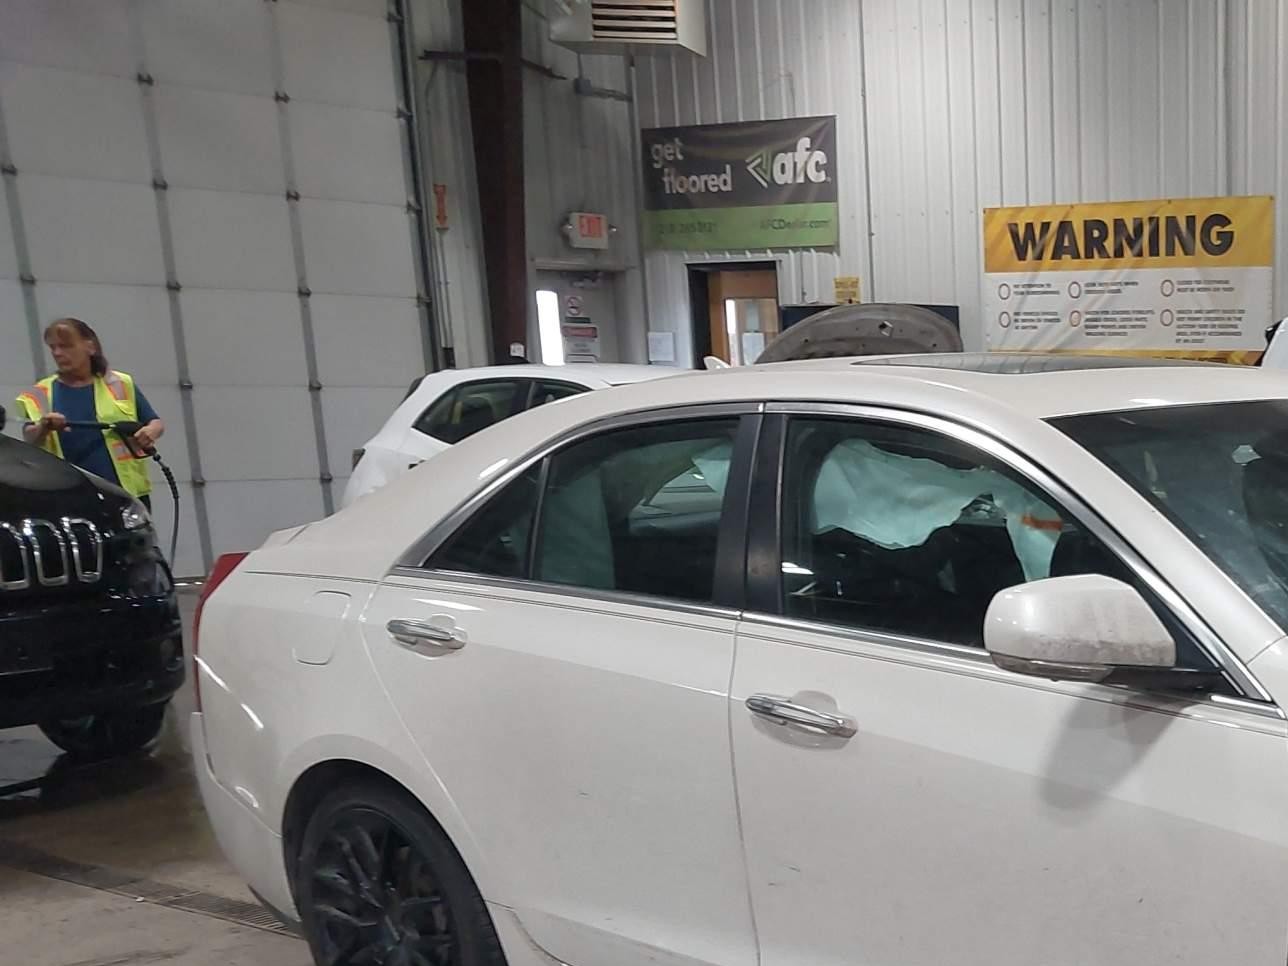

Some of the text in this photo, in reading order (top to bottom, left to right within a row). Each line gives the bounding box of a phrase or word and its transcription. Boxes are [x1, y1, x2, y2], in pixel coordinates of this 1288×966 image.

[651, 137, 684, 169] get
[773, 136, 828, 185] afc
[662, 164, 733, 194] floored
[1008, 213, 1234, 261] WARNING
